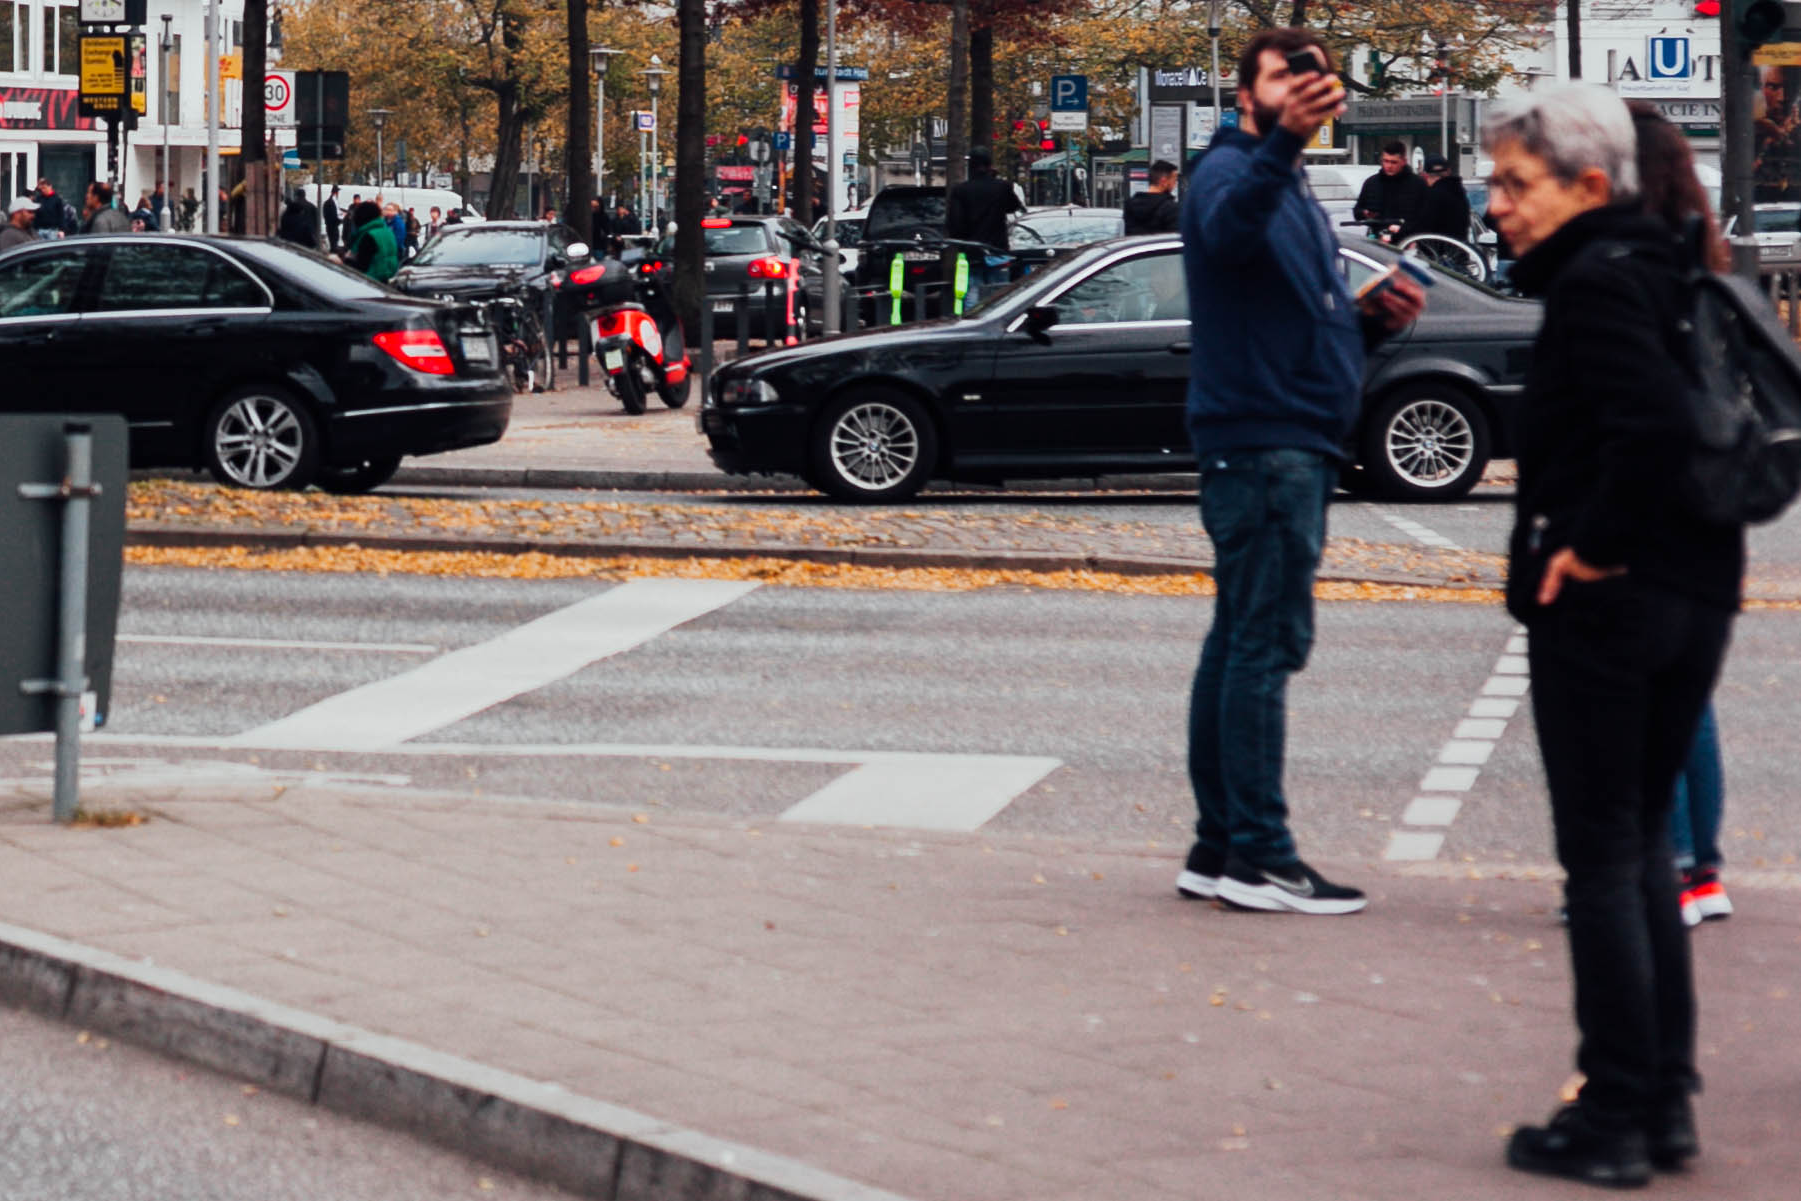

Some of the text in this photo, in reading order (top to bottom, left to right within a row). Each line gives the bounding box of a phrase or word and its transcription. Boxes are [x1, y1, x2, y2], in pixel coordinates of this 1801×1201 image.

[1655, 39, 1685, 76] U
[265, 84, 285, 102] 30
[1057, 80, 1076, 106] P
